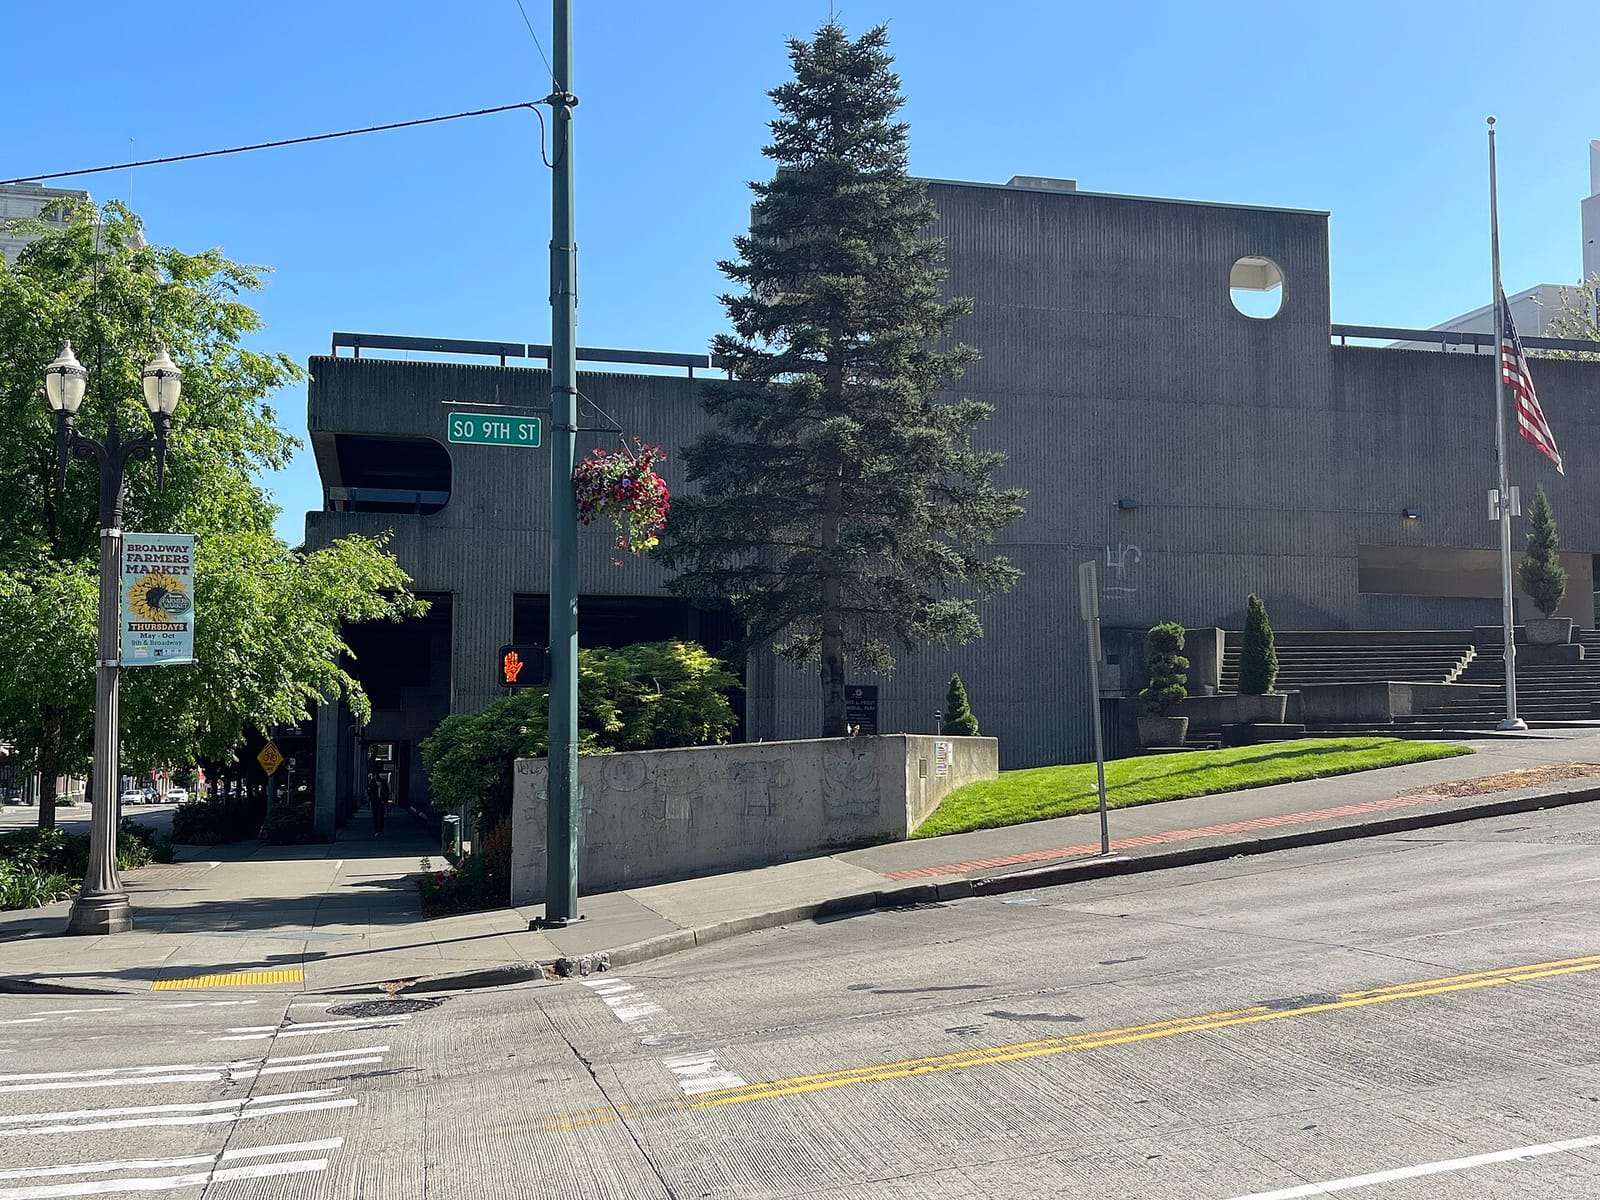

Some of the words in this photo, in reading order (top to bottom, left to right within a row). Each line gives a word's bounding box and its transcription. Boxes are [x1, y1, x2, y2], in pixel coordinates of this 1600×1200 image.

[454, 421, 474, 437] SO
[482, 422, 510, 439] 9TH
[518, 424, 536, 440] ST
[127, 544, 189, 553] BROADWAY
[127, 553, 189, 563] FARMERS
[126, 564, 189, 575] MARKET
[131, 623, 184, 631] THURSDAYS
